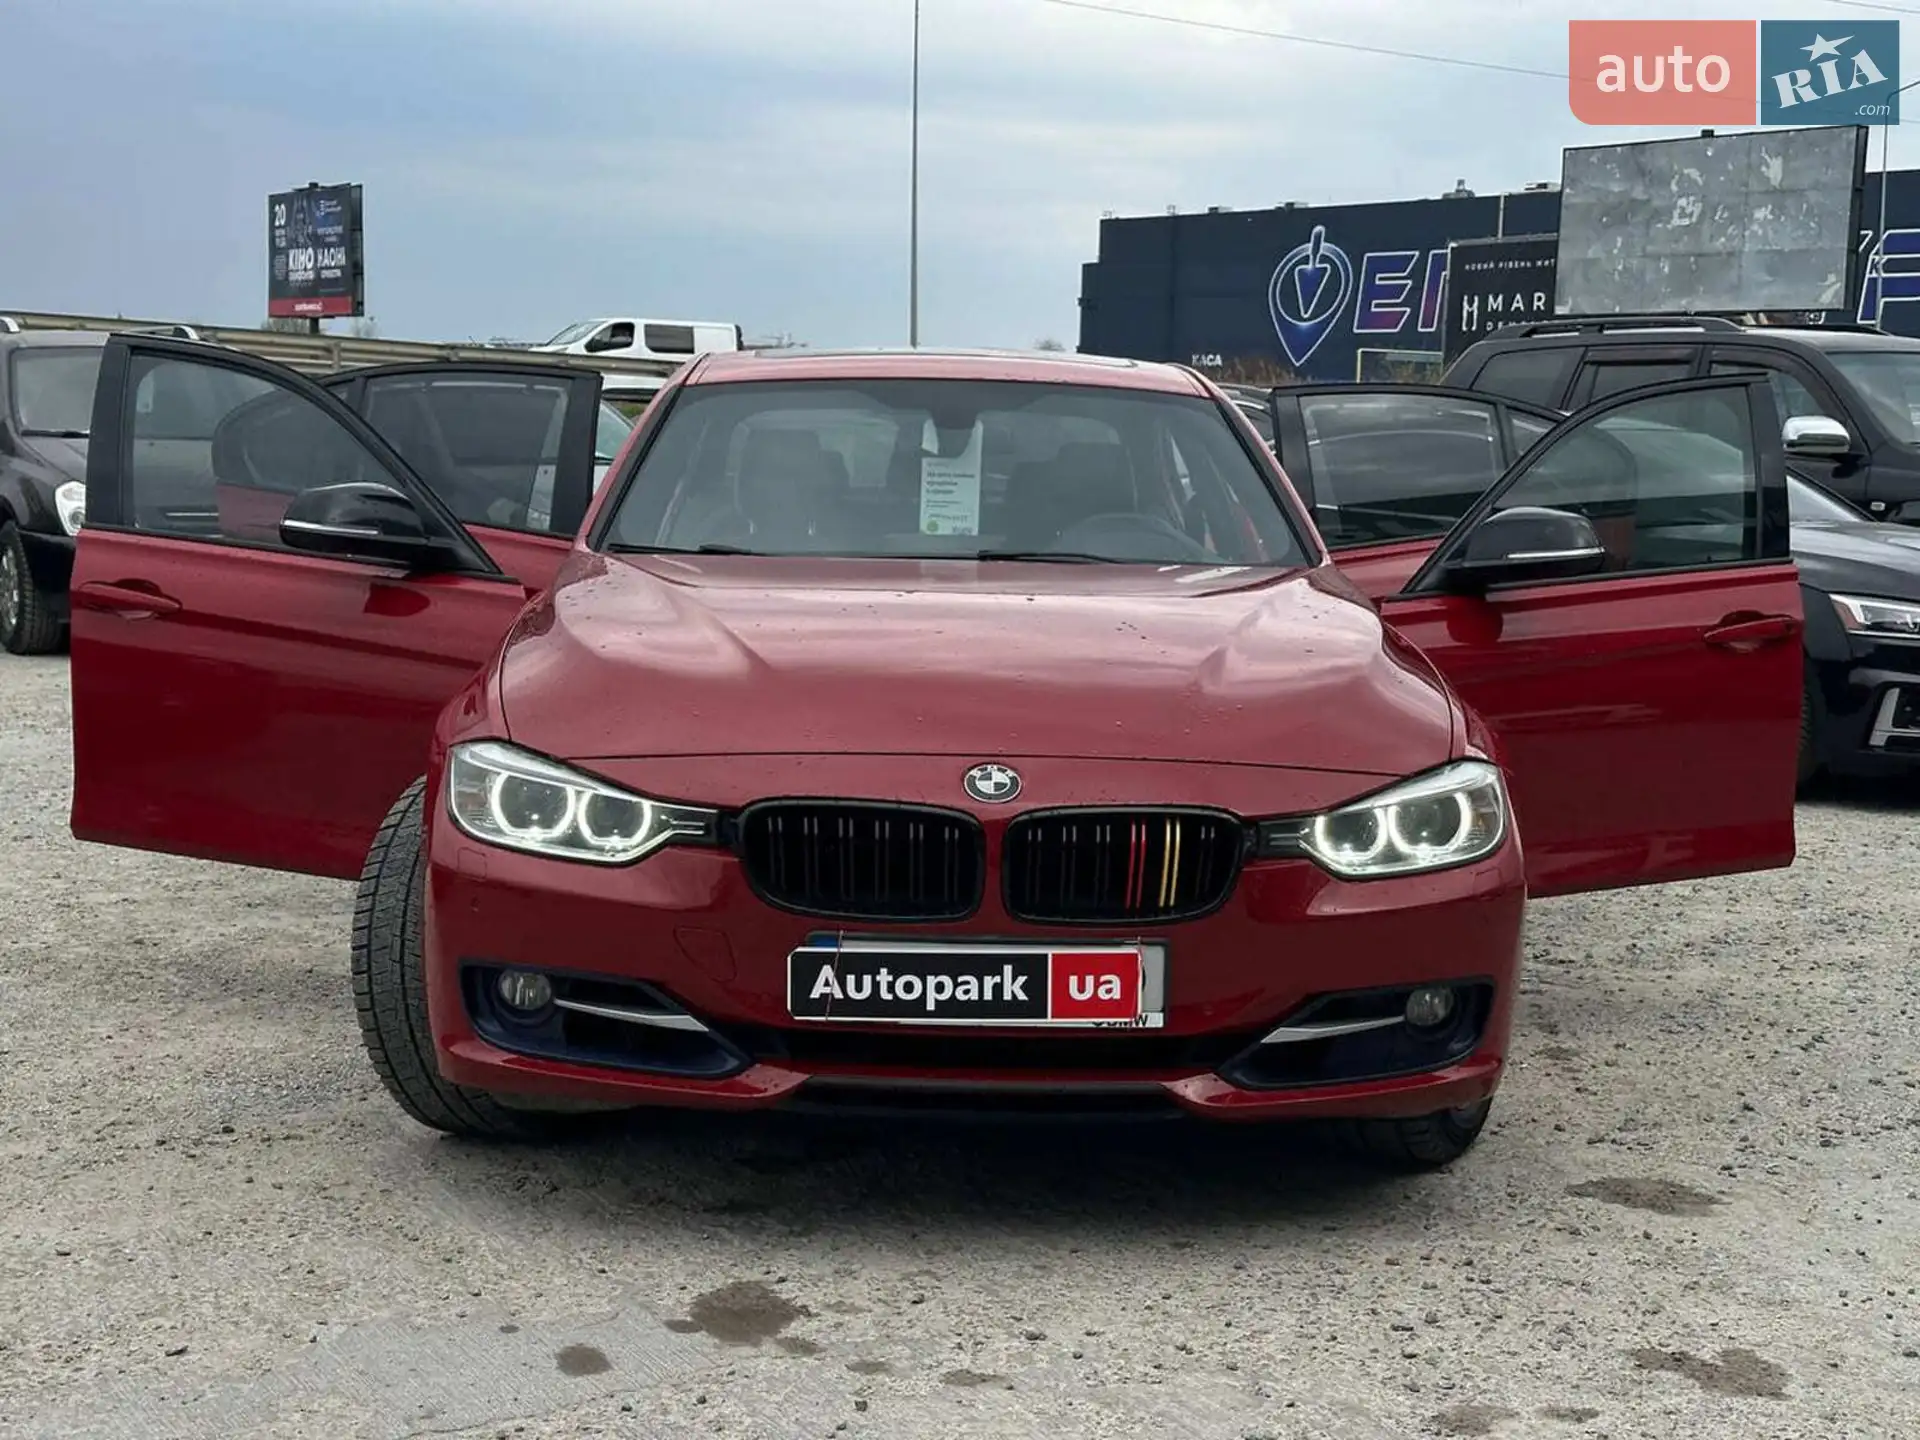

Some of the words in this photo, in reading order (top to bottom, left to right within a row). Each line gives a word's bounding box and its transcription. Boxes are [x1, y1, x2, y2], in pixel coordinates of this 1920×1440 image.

[274, 204, 286, 226] 20
[1191, 354, 1223, 367] КАСА
[809, 963, 1028, 1011] Autopark
[1068, 973, 1122, 1001] ua
